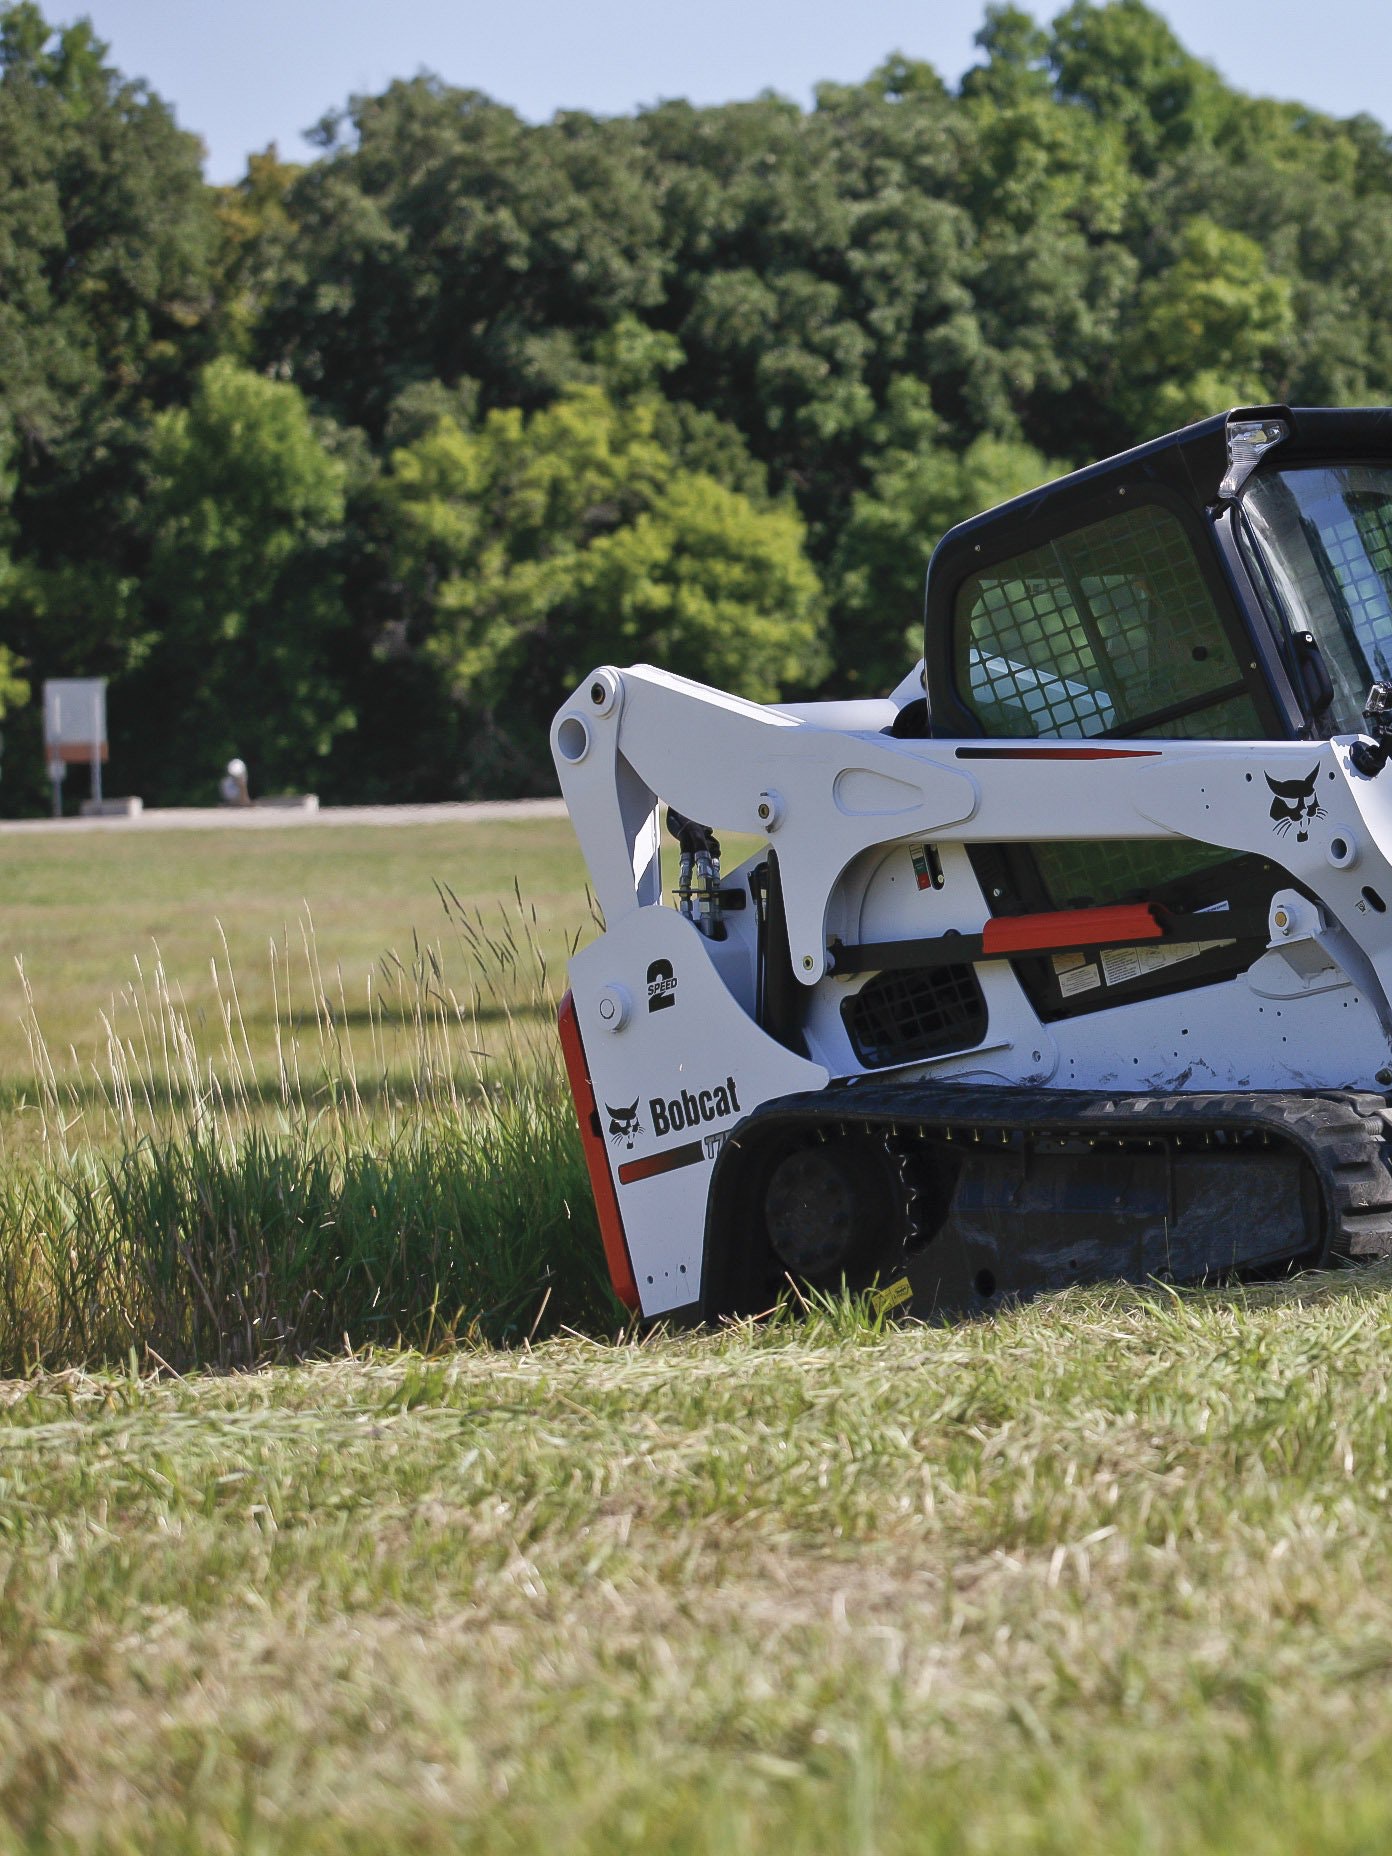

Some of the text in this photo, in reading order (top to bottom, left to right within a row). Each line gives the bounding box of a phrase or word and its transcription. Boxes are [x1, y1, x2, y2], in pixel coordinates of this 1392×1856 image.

[647, 958, 675, 1013] 2
[647, 977, 678, 996] SPEED
[648, 1076, 740, 1137] Bobcat
[704, 1129, 733, 1160] T7
